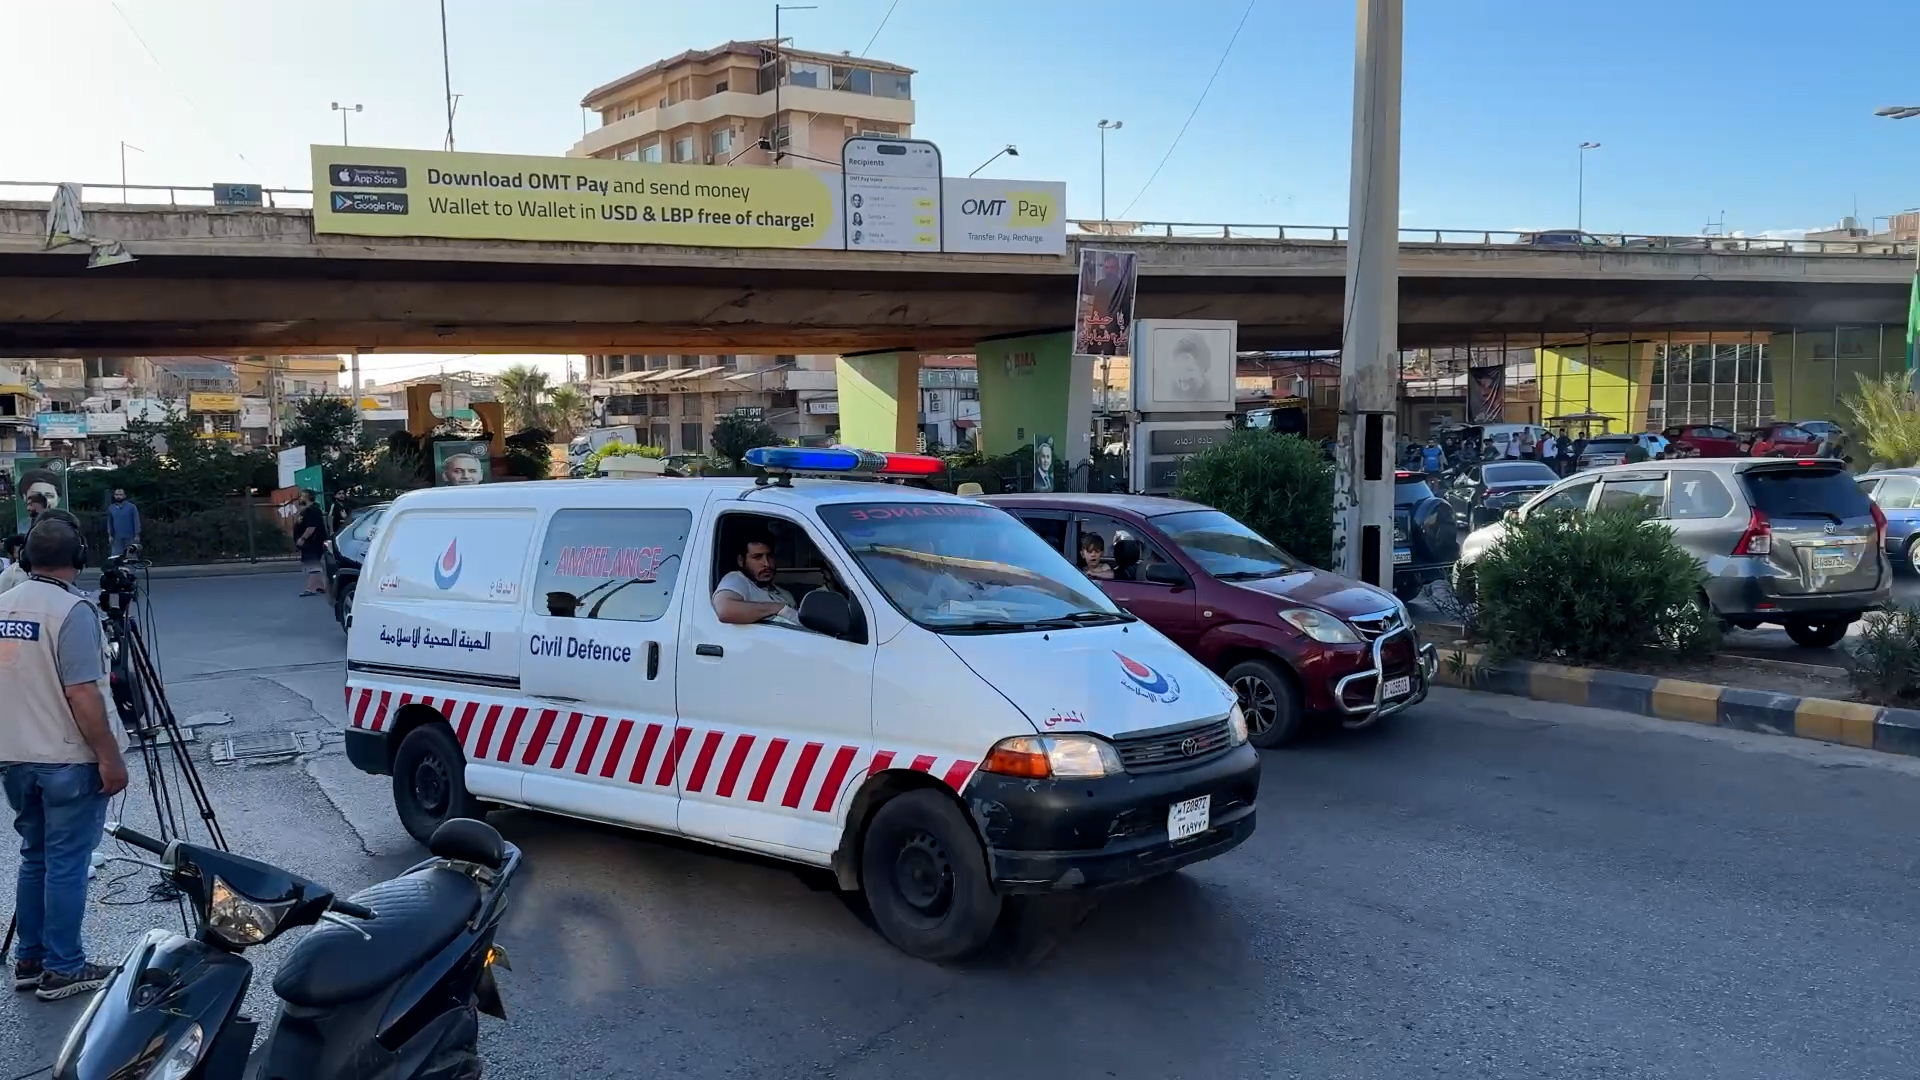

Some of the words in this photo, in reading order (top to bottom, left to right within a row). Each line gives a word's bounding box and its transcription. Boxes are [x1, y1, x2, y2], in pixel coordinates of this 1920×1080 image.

[848, 158, 885, 167] Recipients
[353, 174, 372, 184] App
[374, 175, 398, 184] Store
[428, 168, 523, 188] Download
[528, 173, 571, 191] OMT
[577, 175, 608, 196] Pay
[613, 178, 645, 194] and
[650, 180, 690, 196] send
[695, 185, 750, 202] money
[354, 201, 385, 211] Google
[387, 202, 404, 212] Play
[429, 197, 490, 216] Wallet
[494, 201, 513, 216] to
[517, 201, 576, 218] Wallet
[580, 203, 596, 220] in
[601, 205, 637, 221] USD
[643, 206, 656, 222] &
[661, 207, 693, 223] LBP
[698, 208, 731, 225] free
[735, 210, 752, 226] of
[756, 211, 814, 231] charge!
[961, 199, 1007, 216] OMT
[1018, 200, 1047, 222] Pay
[552, 546, 664, 580] AMBULANCE
[489, 578, 517, 598] الدفاع
[0, 621, 33, 639] RESS
[380, 624, 421, 649] الاسلامية
[423, 627, 458, 649] الصحية
[530, 634, 562, 657] Civil
[566, 637, 631, 662] Defence
[1044, 706, 1086, 729] المدني
